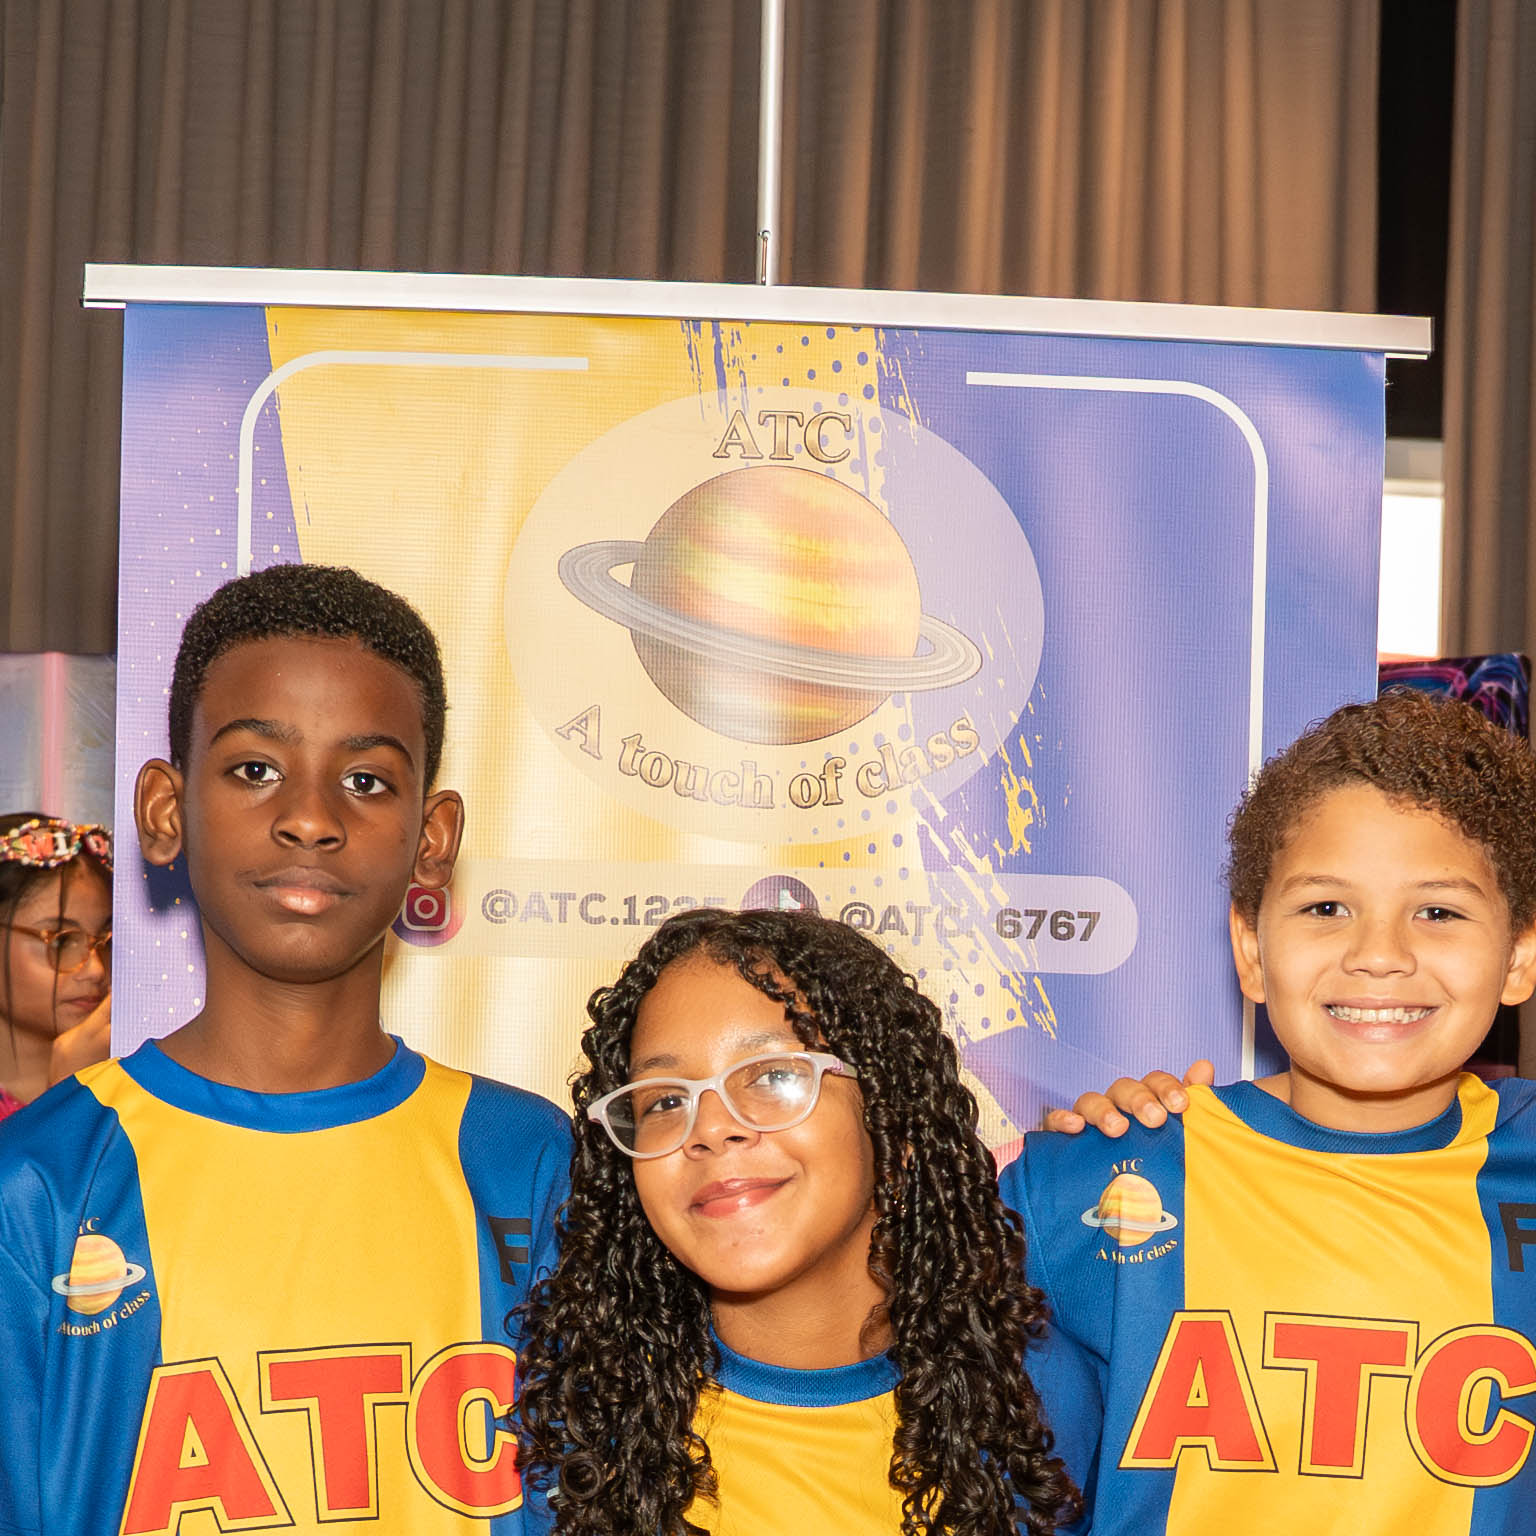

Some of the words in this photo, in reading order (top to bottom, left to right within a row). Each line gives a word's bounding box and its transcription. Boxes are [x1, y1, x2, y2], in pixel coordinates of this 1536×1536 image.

[712, 409, 853, 465] ATC
[555, 703, 604, 759] A
[617, 731, 776, 811] touch
[788, 757, 846, 809] of
[854, 715, 982, 799] class
[1146, 1239, 1179, 1261] class
[102, 1311, 119, 1329] of
[119, 1289, 152, 1320] class
